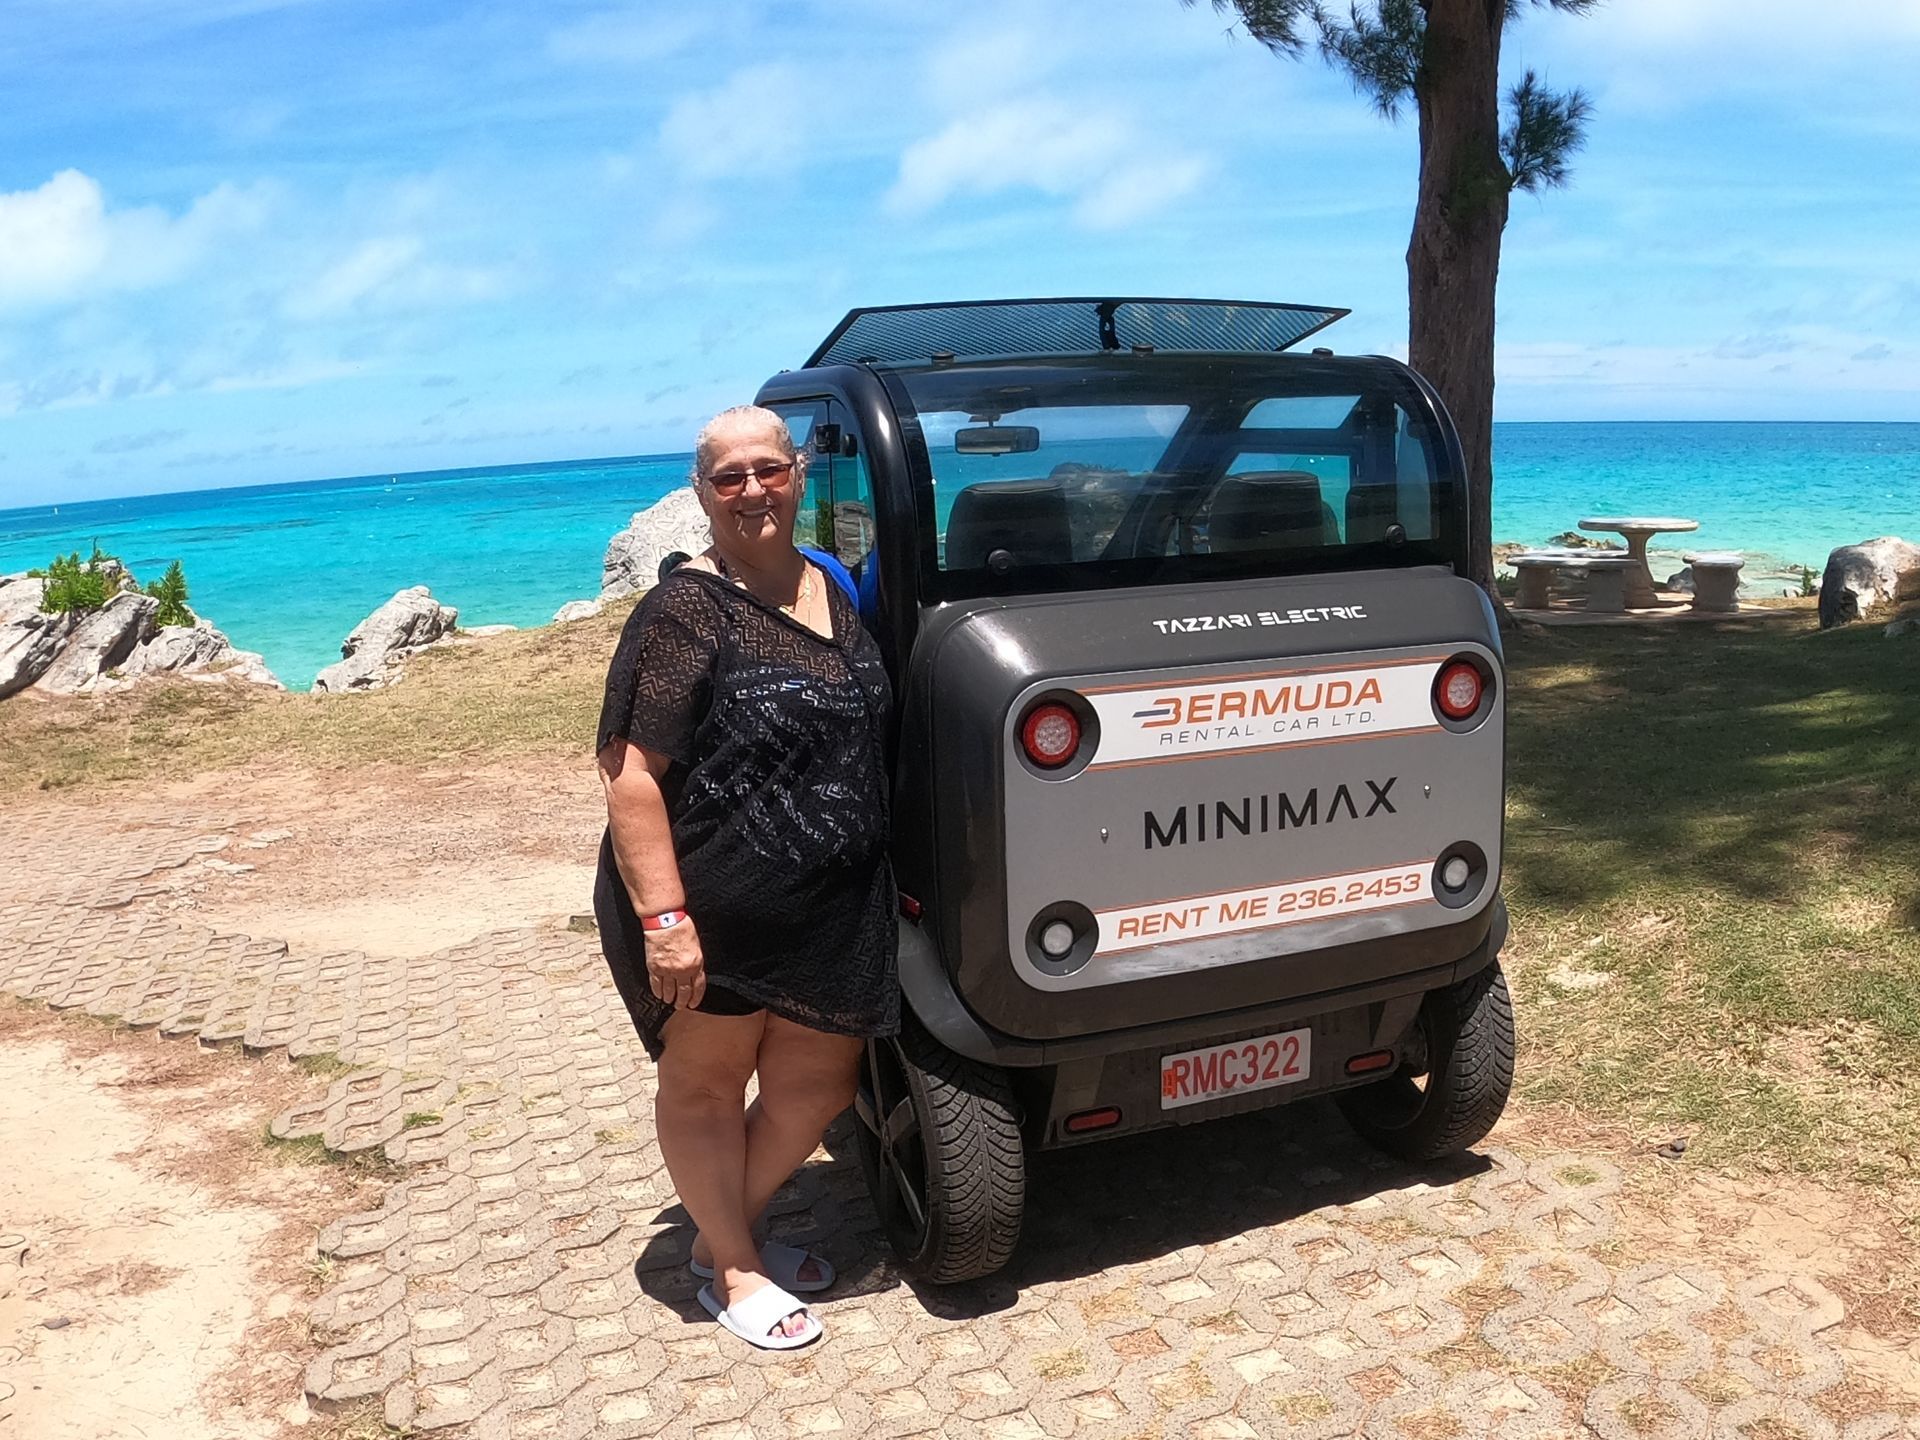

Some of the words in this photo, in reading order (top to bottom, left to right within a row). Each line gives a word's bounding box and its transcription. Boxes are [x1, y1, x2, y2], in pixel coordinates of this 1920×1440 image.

[1153, 614, 1252, 634] TAZZARI
[1257, 606, 1367, 625] ELECTRIC
[1132, 678, 1382, 728] BERMUDA
[1160, 725, 1254, 745] RENTAL
[1273, 717, 1319, 733] CAR
[1332, 711, 1376, 727] LTD.
[1144, 777, 1397, 849] MINIMAX
[1117, 906, 1209, 939] RENT
[1219, 897, 1269, 923] ME
[1277, 873, 1421, 914] 236.2453
[1171, 1036, 1300, 1099] RMC322
